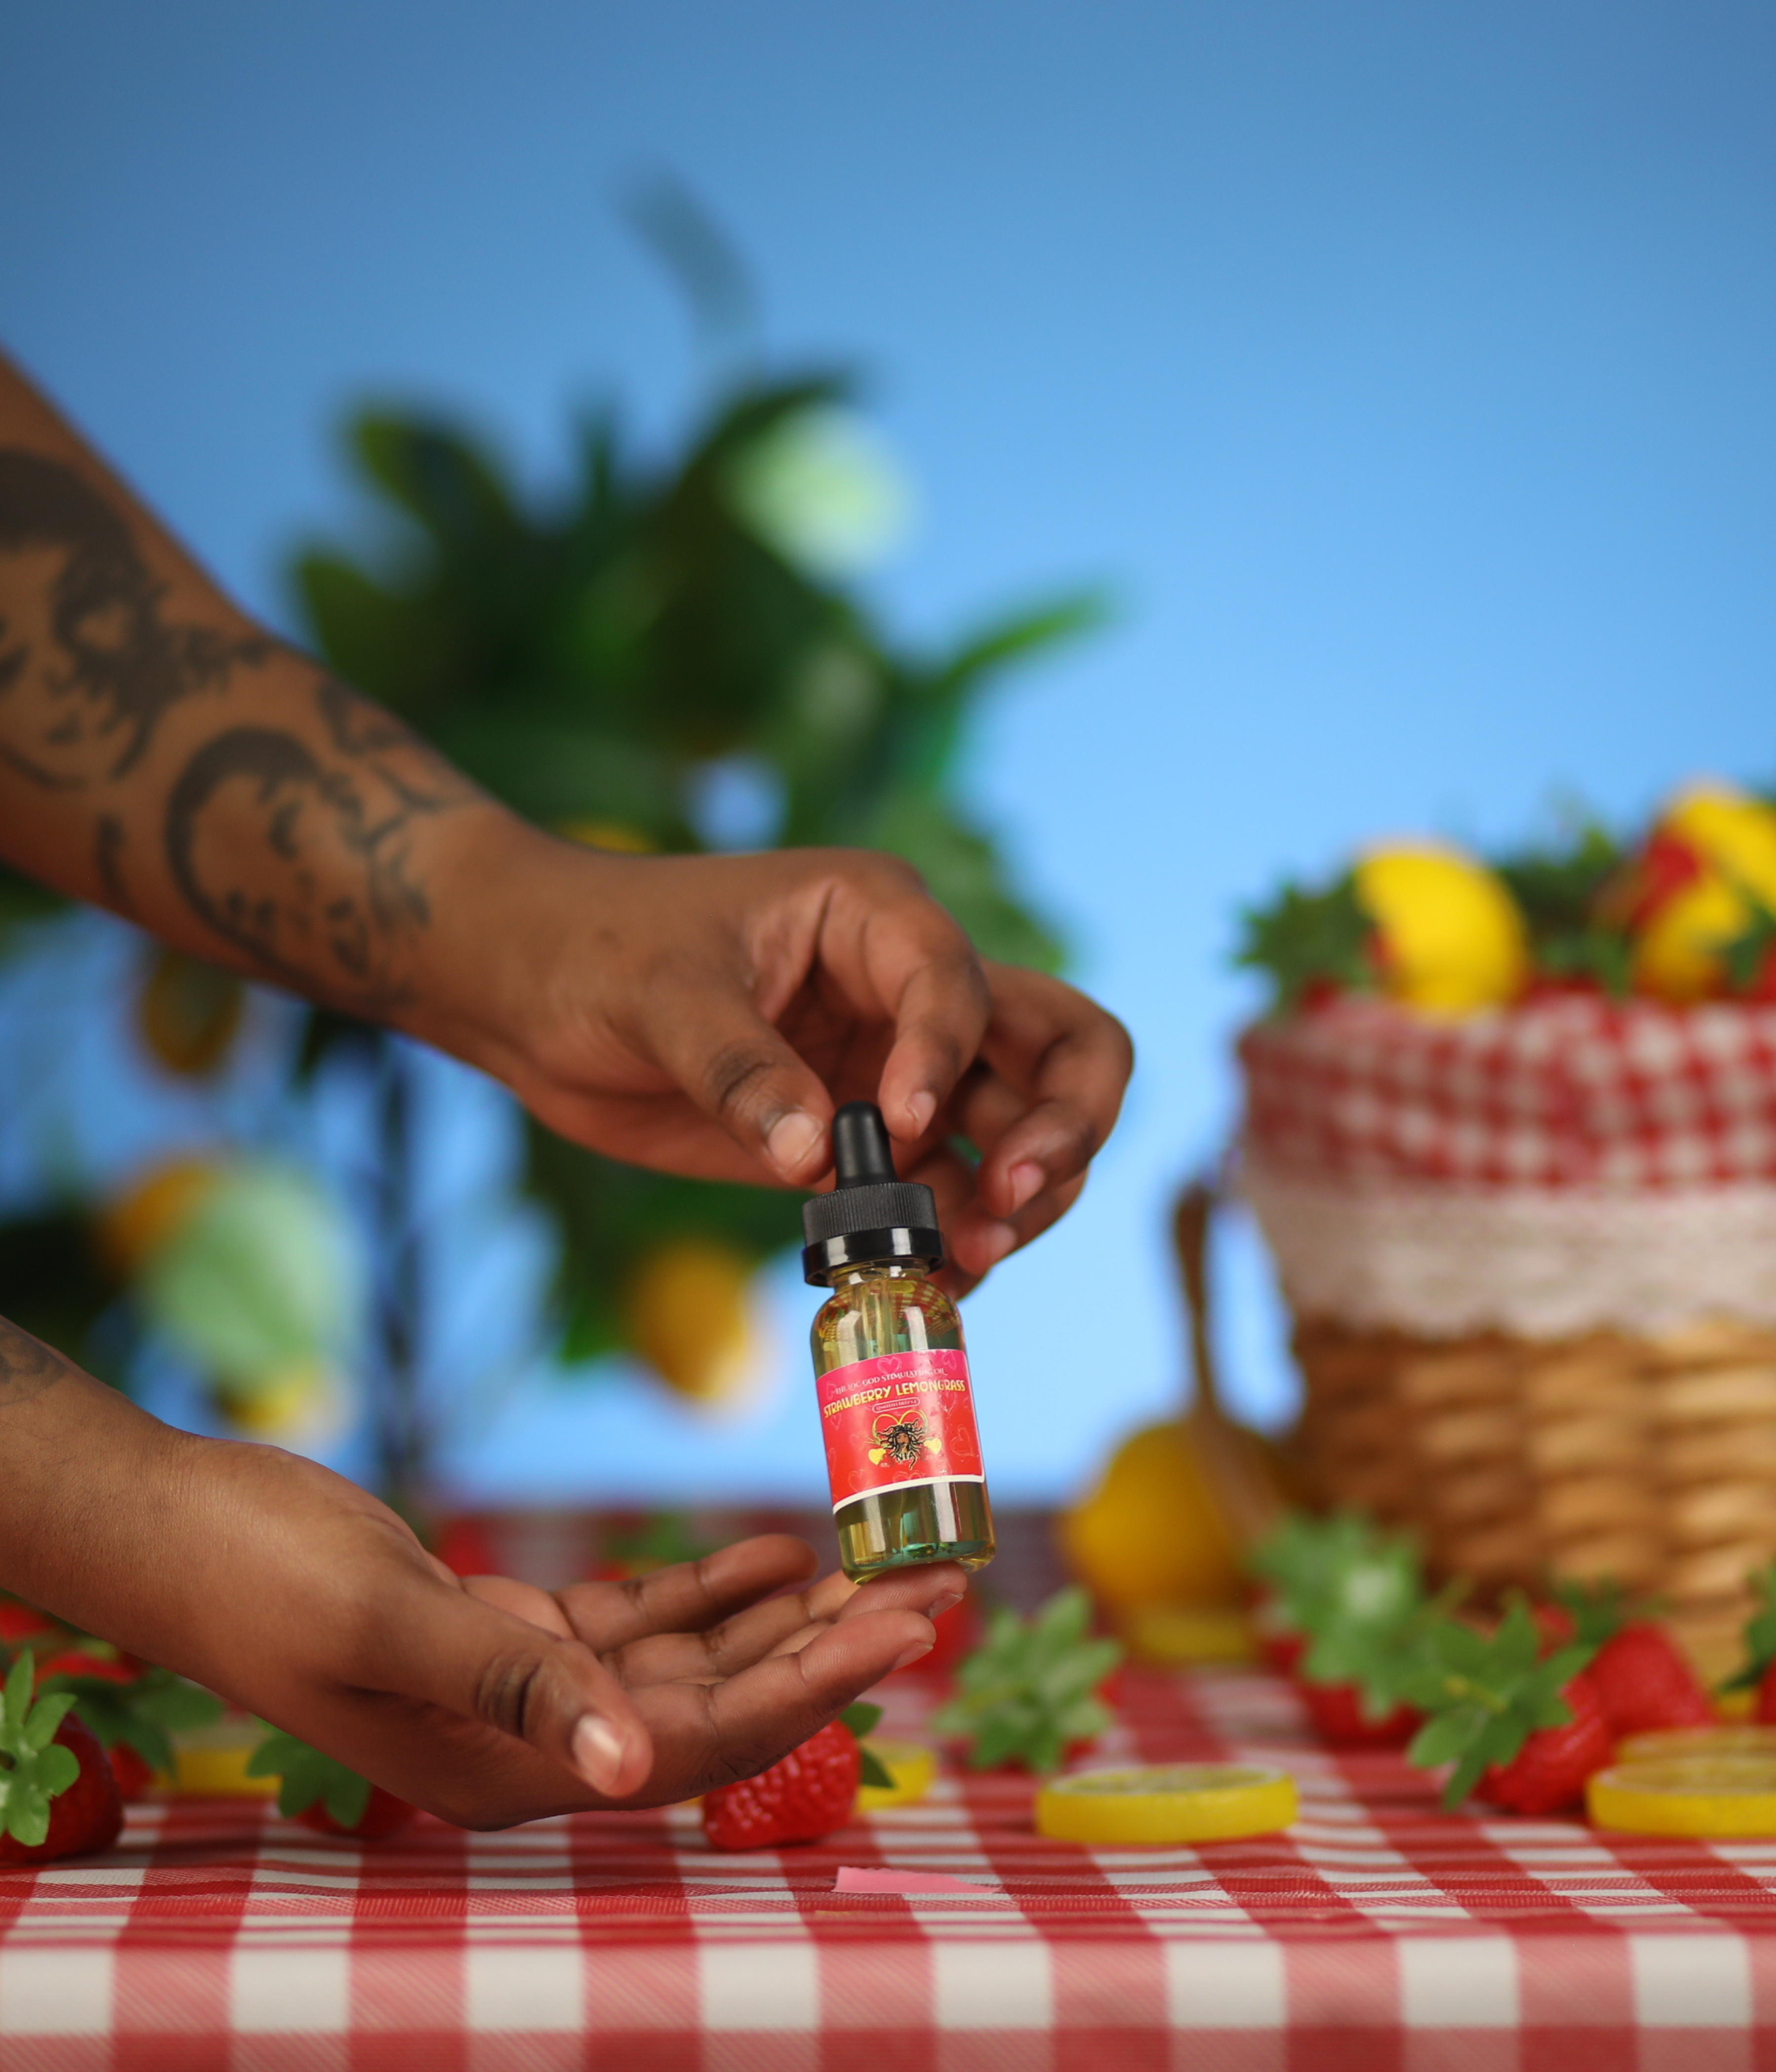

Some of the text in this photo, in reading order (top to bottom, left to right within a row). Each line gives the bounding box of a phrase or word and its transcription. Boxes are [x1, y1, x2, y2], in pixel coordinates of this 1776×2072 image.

[835, 1386, 848, 1394] THE
[848, 1382, 861, 1390] LOC
[862, 1376, 880, 1385] GOD
[881, 1369, 933, 1381] STIMULATING
[824, 1385, 891, 1418] STRAWBERRY
[895, 1379, 965, 1396] LEMONGRASS
